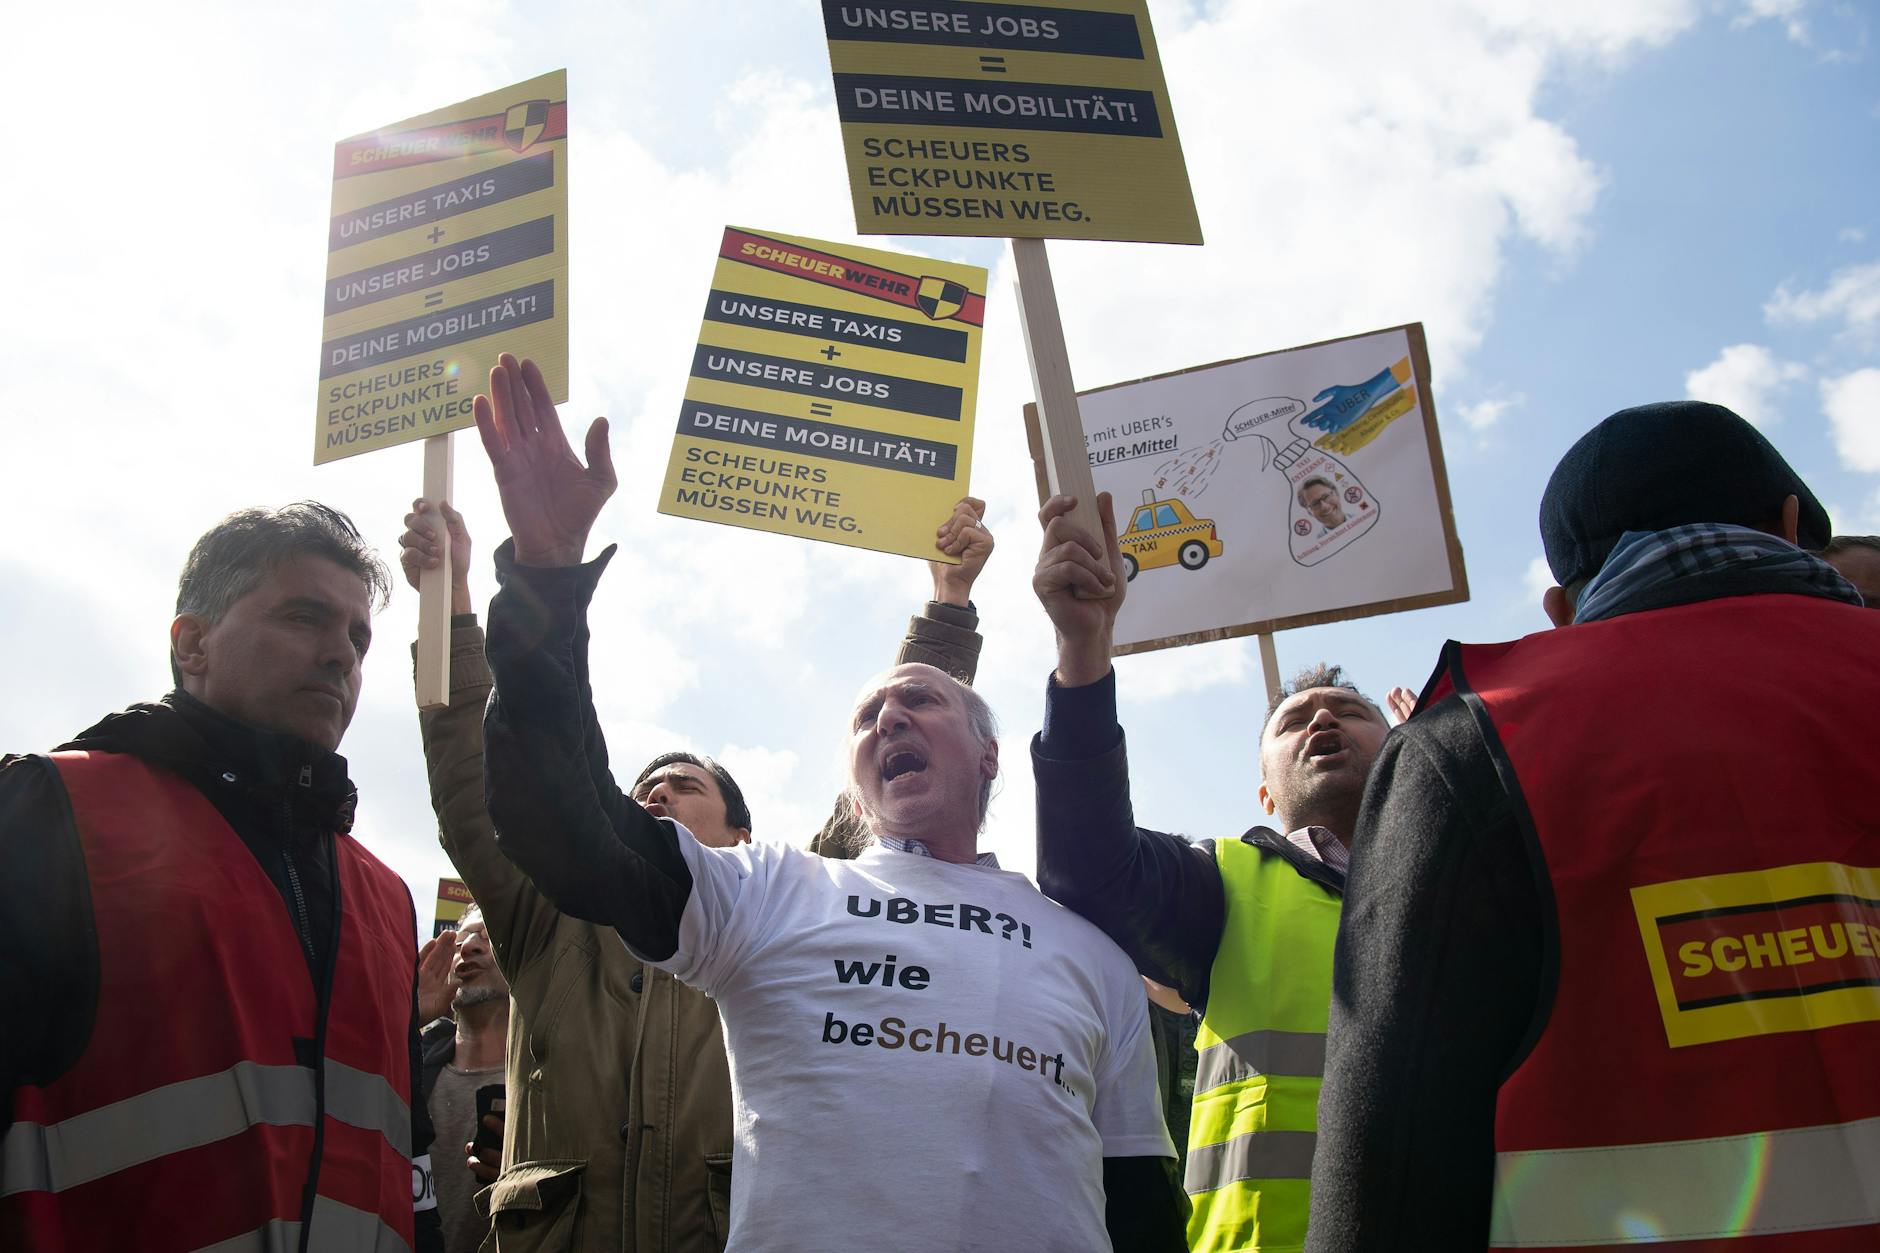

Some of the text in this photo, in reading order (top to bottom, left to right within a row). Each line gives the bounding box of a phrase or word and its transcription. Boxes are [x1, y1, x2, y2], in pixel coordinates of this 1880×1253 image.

[841, 7, 1059, 39] UNSERE JOBS
[854, 87, 1138, 122] DEINE MOBILITÄT!
[351, 125, 497, 165] SCHEUERWEHR
[863, 138, 1029, 163] SCHEUERS
[868, 167, 1055, 192] ECKPUNKTE
[340, 179, 496, 238] UNSERE TAXIS
[873, 192, 1091, 222] MÜSSEN WEG.
[336, 245, 490, 301] UNSERE JOBS
[741, 242, 910, 297] SCHEUERWEHR
[331, 295, 537, 366] DEINE MOBILITÄT!
[720, 300, 902, 343] UNSERE TAXIS
[329, 360, 445, 403] SCHEUERS
[707, 355, 890, 399] UNSERE JOBS
[328, 378, 458, 425] ECKPUNKTE
[1234, 403, 1296, 431] SCHEUER-Mittel
[1337, 388, 1371, 414] UBER
[326, 409, 416, 449] MÜSSEN
[694, 411, 937, 467] DEINE MOBILITÄT!
[1093, 427, 1117, 443] mit
[686, 447, 827, 483] SCHEUERS
[681, 468, 840, 507] ECKPUNKTE
[676, 488, 863, 534] MÜSSEN WEG.
[1132, 540, 1158, 553] TAXI
[846, 895, 1032, 949] UBER?!
[834, 954, 930, 990] wie
[822, 1012, 1076, 1097] beScheuert...
